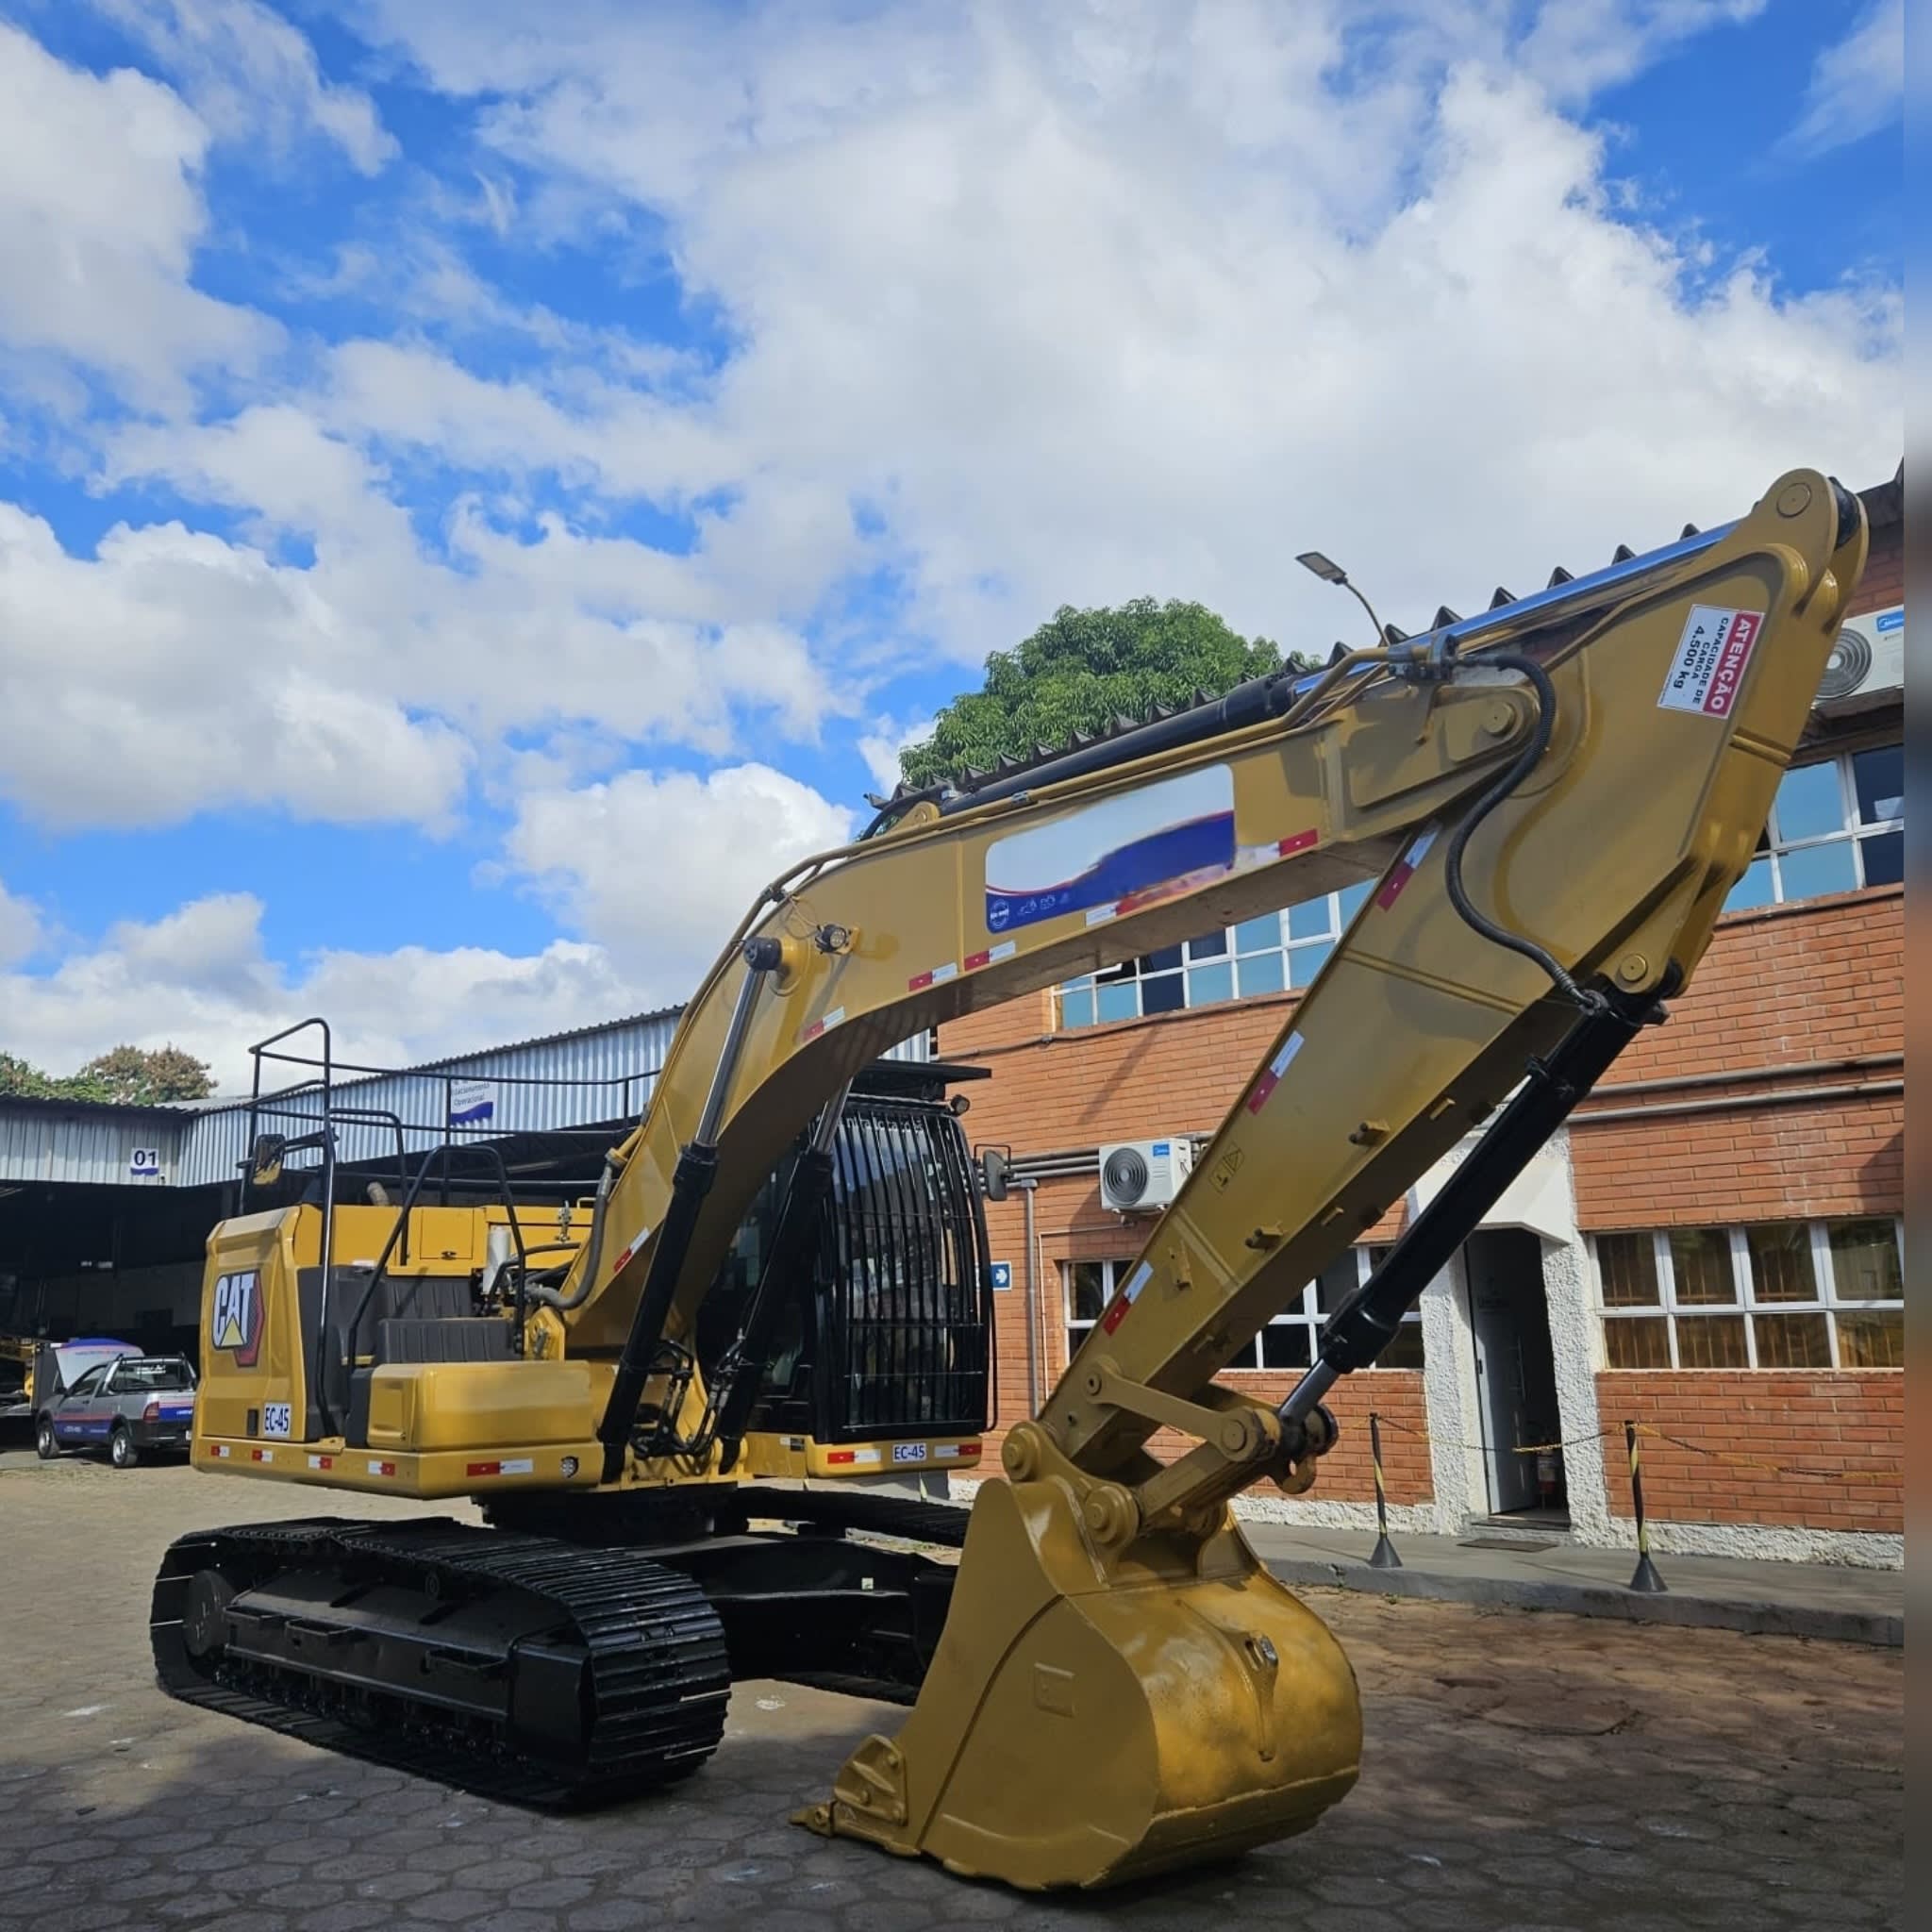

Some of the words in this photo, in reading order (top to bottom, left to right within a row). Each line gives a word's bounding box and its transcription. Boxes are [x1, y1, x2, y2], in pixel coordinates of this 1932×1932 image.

[1683, 625, 1706, 667] 4.500
[1691, 641, 1710, 679] CARGA
[1698, 617, 1729, 687] CAPACIDADE
[1710, 618, 1752, 709] ATENÇÃO
[1673, 671, 1690, 690] kg
[1692, 689, 1704, 705] DE
[134, 1149, 157, 1166] 01
[212, 1273, 256, 1347] CAT
[264, 1407, 291, 1432] EC-45
[894, 1444, 925, 1460] EC-45
